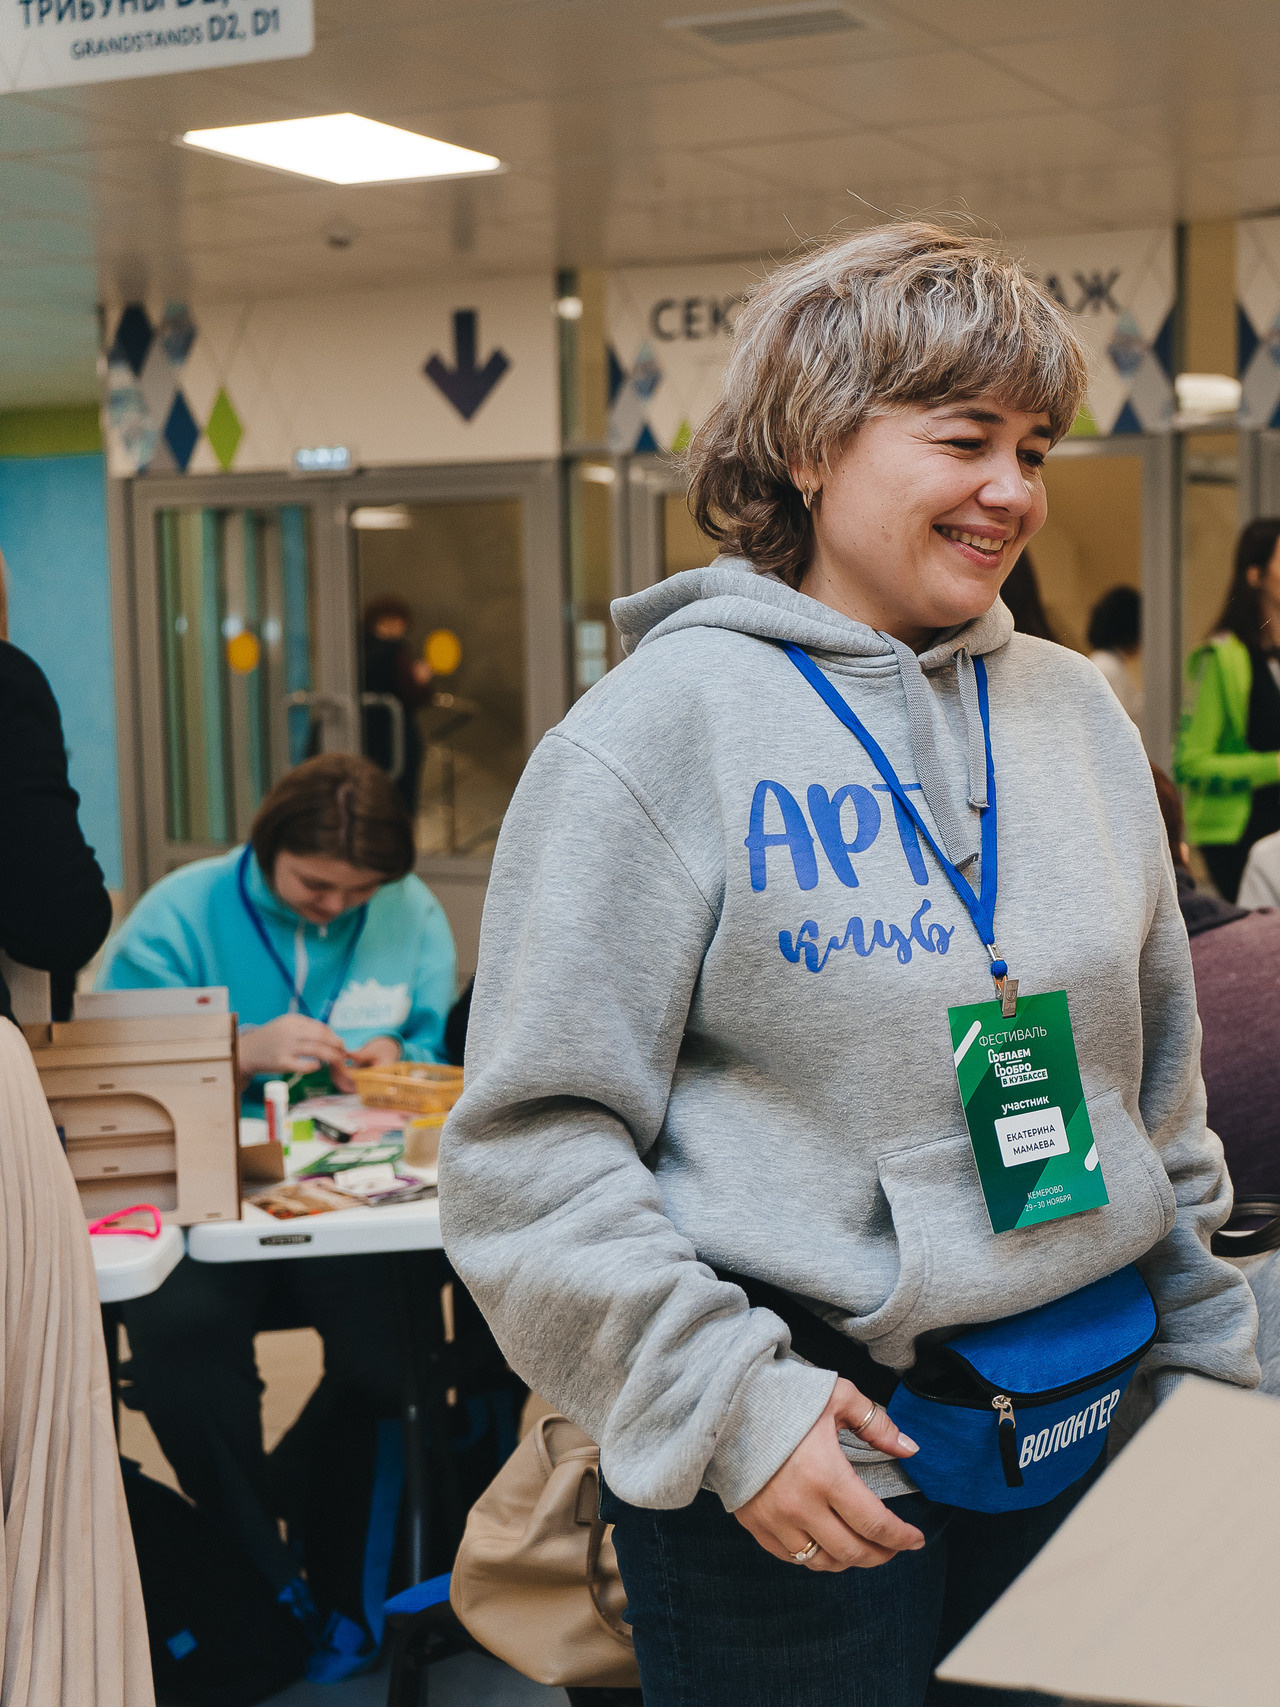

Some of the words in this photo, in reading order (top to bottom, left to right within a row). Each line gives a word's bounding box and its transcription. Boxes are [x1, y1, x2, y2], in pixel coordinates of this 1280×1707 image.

[70, 24, 203, 60] GRANDSTANDS
[251, 6, 280, 36] D1
[744, 779, 930, 893] АРТ
[778, 899, 955, 973] клуб
[979, 1026, 1047, 1046] ФЕСТИВАЛЬ
[1009, 1070, 1047, 1084] КУЗБАССЕ
[1001, 1096, 1050, 1115] участник
[1006, 1124, 1056, 1142] ЕКАТЕРИНА
[1013, 1139, 1056, 1155] МАМАЕВА
[1027, 1184, 1064, 1200] КЕМЕРОВО
[1046, 1193, 1072, 1206] НОЯБРЯ
[1019, 1388, 1121, 1469] ВОЛОНТЕР
